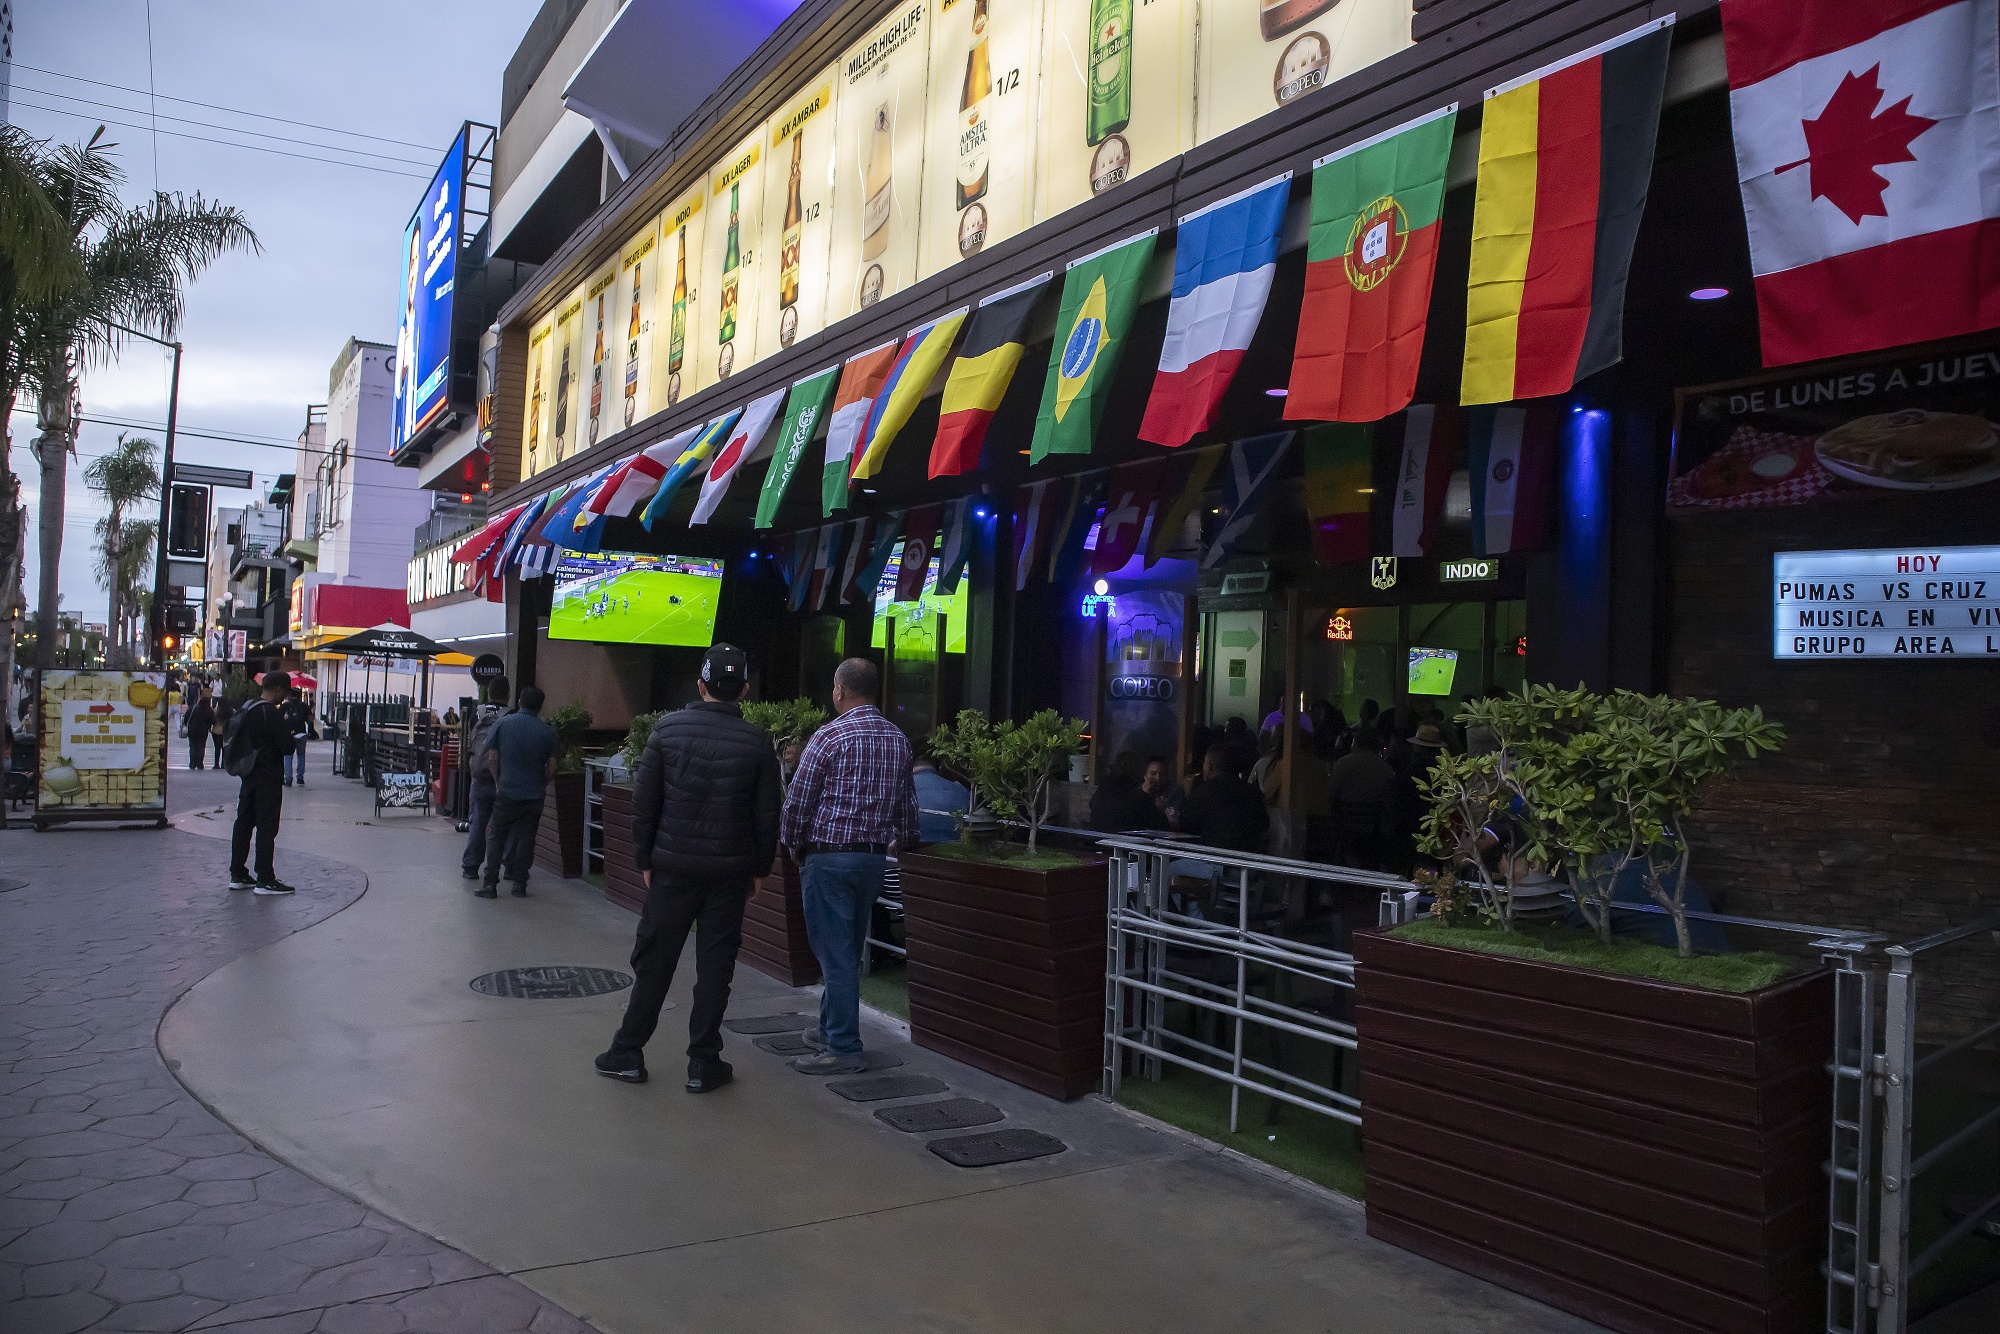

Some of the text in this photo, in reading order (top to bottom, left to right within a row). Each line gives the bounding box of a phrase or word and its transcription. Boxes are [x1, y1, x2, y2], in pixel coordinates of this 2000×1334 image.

[848, 4, 921, 77] MILLER HIGH LIFE
[1092, 35, 1130, 66] Heineken
[849, 65, 871, 85] CERVEZA
[996, 67, 1020, 97] 1/2
[1280, 70, 1322, 100] COPEO
[780, 97, 821, 140] XX AMBAR
[960, 119, 988, 147] AMSTEL
[961, 132, 987, 157] ULTRA
[721, 154, 751, 188] XX LAGER
[1094, 166, 1125, 191] COPEO
[675, 205, 691, 227] INDIO
[805, 202, 821, 225] 1/2
[741, 250, 753, 269] 1/2
[688, 288, 697, 305] 1/2
[1729, 391, 1766, 415] DE
[1774, 372, 1877, 409] LUNES
[1885, 368, 1909, 392] A
[1445, 562, 1489, 579] INDIO
[1896, 554, 1942, 573] HOY
[1779, 580, 1987, 601] PUMAS VS CRUZ
[1082, 605, 1116, 617] ULA
[1799, 608, 1885, 628] MUSICA
[1907, 608, 1936, 627] EN
[369, 639, 419, 649] TECATE
[1327, 629, 1353, 640] Red Bull
[1793, 636, 1866, 655] GRUPO
[1893, 636, 1955, 655] AREA
[1110, 677, 1174, 700] COPEO
